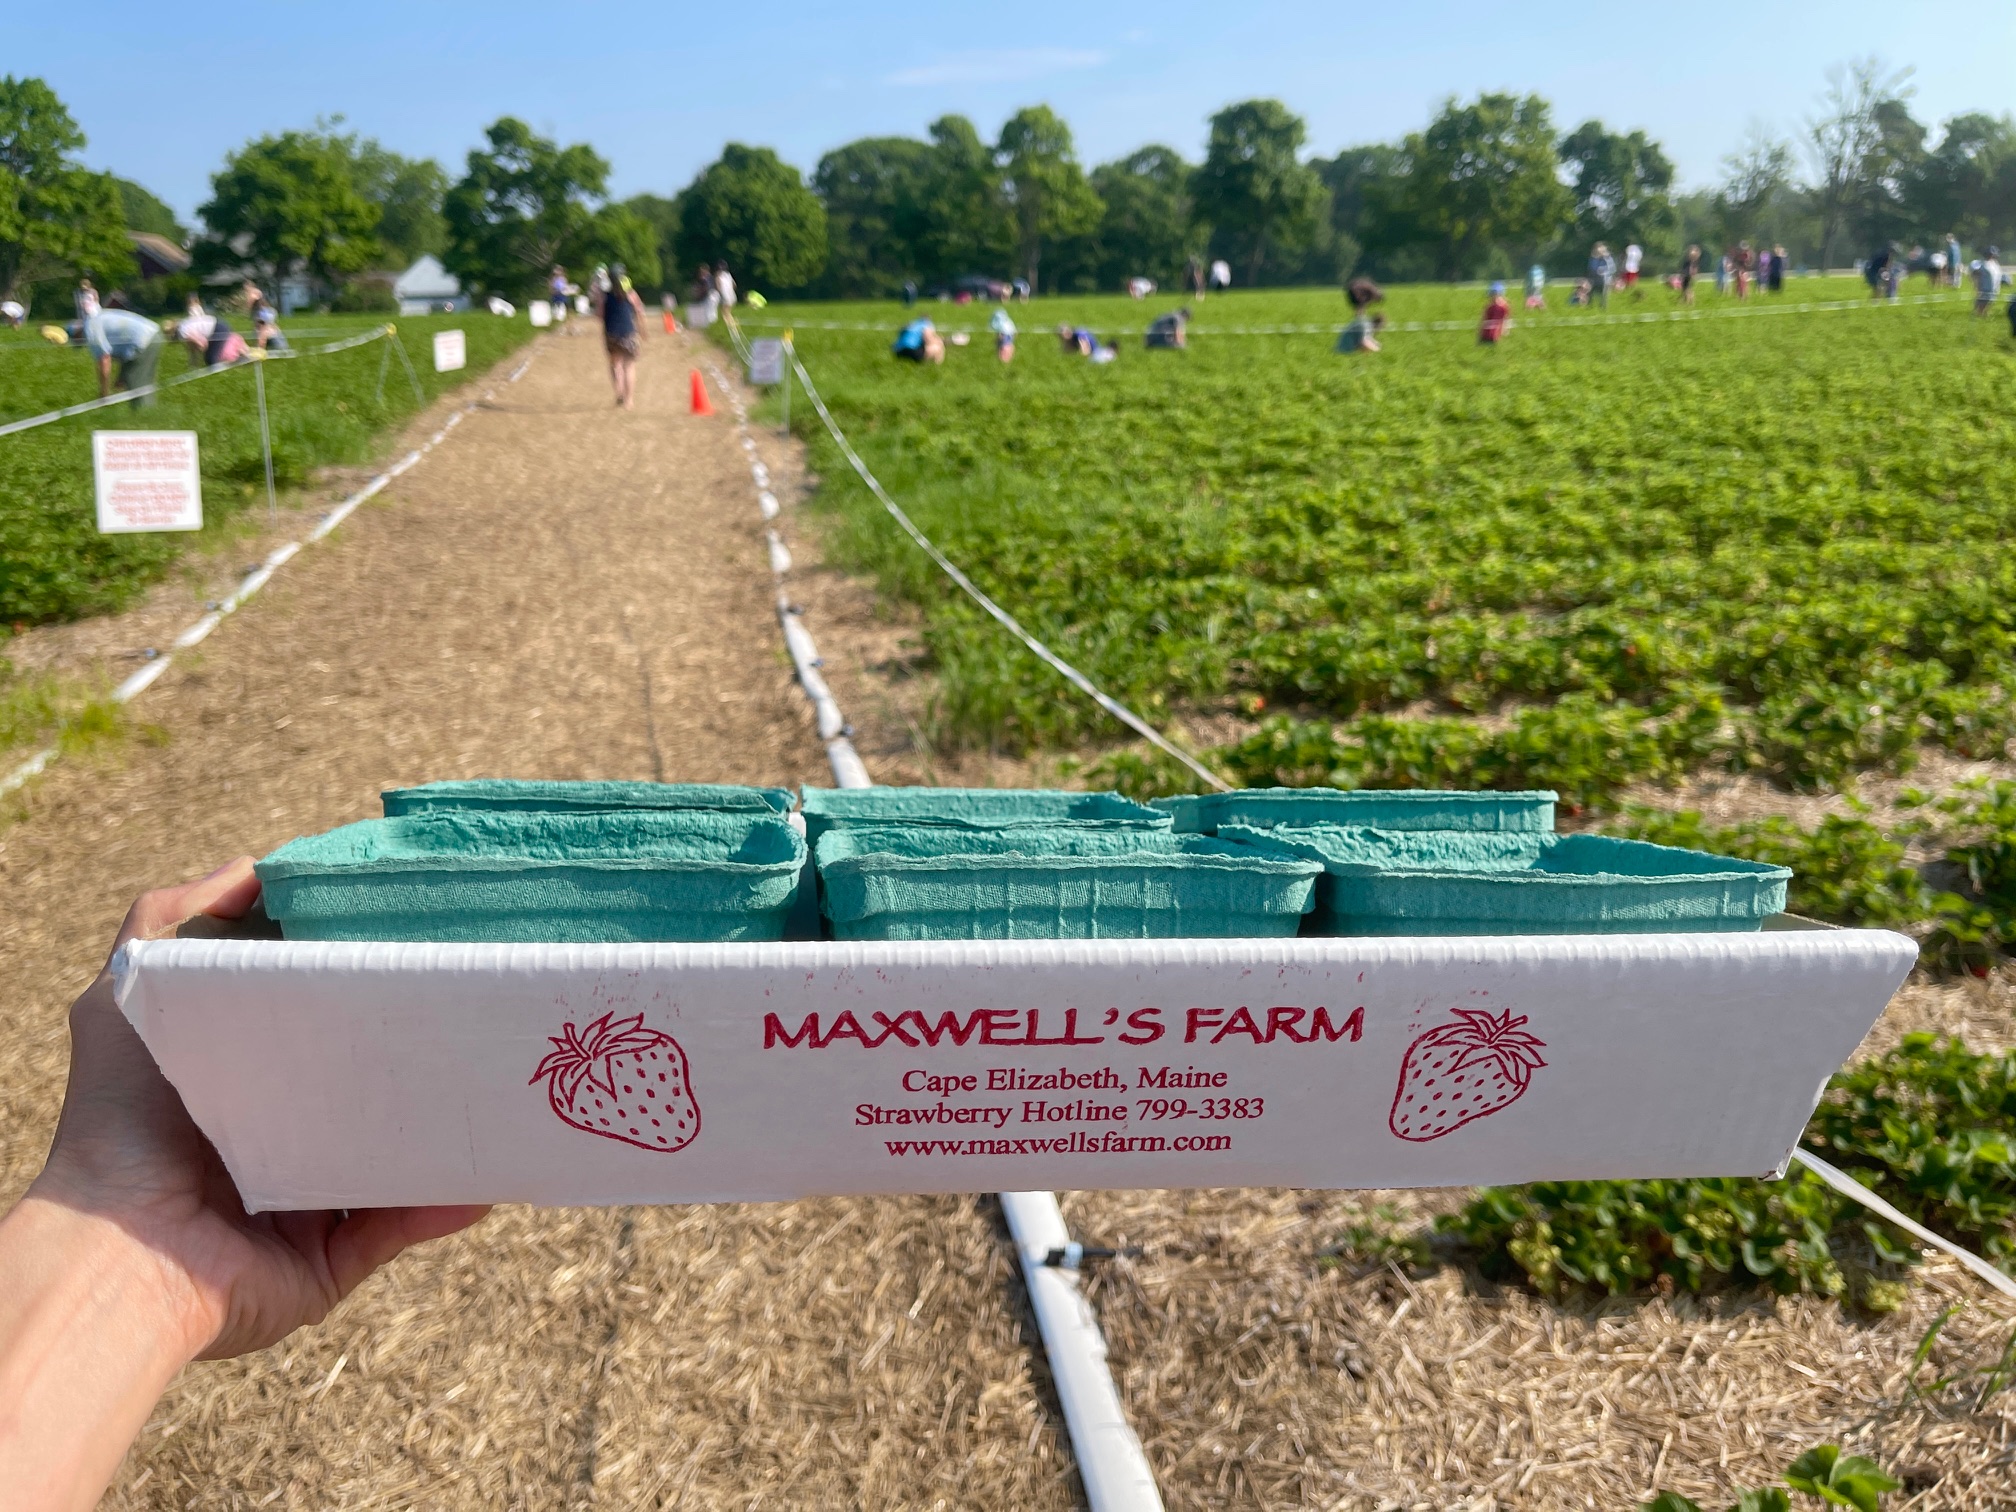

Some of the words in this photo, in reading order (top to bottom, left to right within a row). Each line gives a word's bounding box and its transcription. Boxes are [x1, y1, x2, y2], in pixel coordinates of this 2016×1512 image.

[763, 1007, 1166, 1050] MAXWELL'S
[1183, 1006, 1365, 1045] FARM
[902, 1069, 977, 1098] Cape
[986, 1066, 1129, 1094] Elizabeth,
[1136, 1066, 1228, 1091] Maine
[855, 1101, 1013, 1129] Strawberry
[1020, 1099, 1128, 1123] Hotline
[1136, 1097, 1265, 1121] 799-3383
[884, 1130, 1233, 1157] www.maxwellsfarm.com
